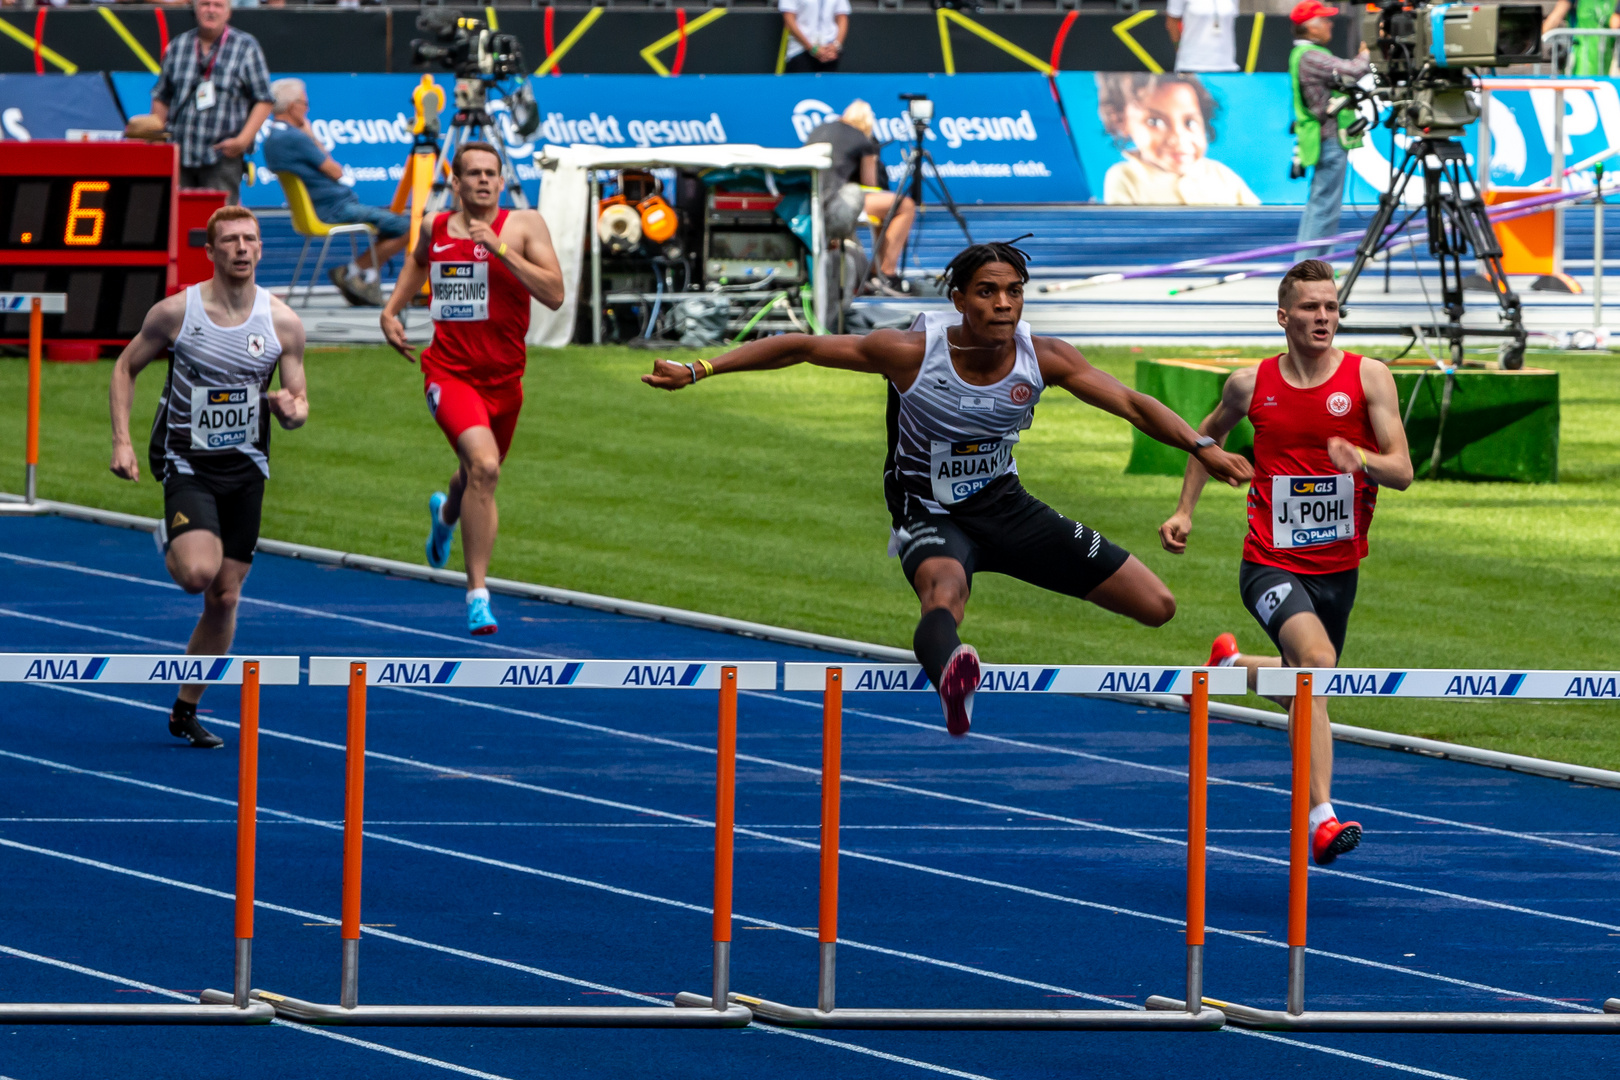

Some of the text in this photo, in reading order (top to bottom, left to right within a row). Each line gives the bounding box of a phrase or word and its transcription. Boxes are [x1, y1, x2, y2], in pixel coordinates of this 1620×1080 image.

[311, 112, 414, 152] gesund
[543, 112, 625, 143] direkt
[628, 112, 727, 147] gesund
[939, 110, 1037, 148] gesund
[456, 266, 471, 276] GLS
[228, 392, 246, 402] GLS
[198, 406, 255, 429] ADOLF
[223, 432, 246, 441] PLAN
[937, 445, 1008, 480] ABUAKU
[1314, 482, 1333, 493] GLS
[1278, 499, 1349, 524] J. POHL
[1311, 528, 1336, 539] PLAN
[1264, 590, 1281, 611] 3
[24, 659, 80, 680] ANA
[148, 660, 203, 681] ANA
[377, 663, 431, 683] ANA
[499, 665, 554, 685] ANA
[622, 665, 676, 686] ANA
[855, 669, 910, 690] ANA
[975, 671, 1030, 691] ANA
[1097, 672, 1151, 692] ANA
[1324, 674, 1378, 695] ANA
[1444, 675, 1498, 696] ANA
[1564, 677, 1618, 697] ANA
